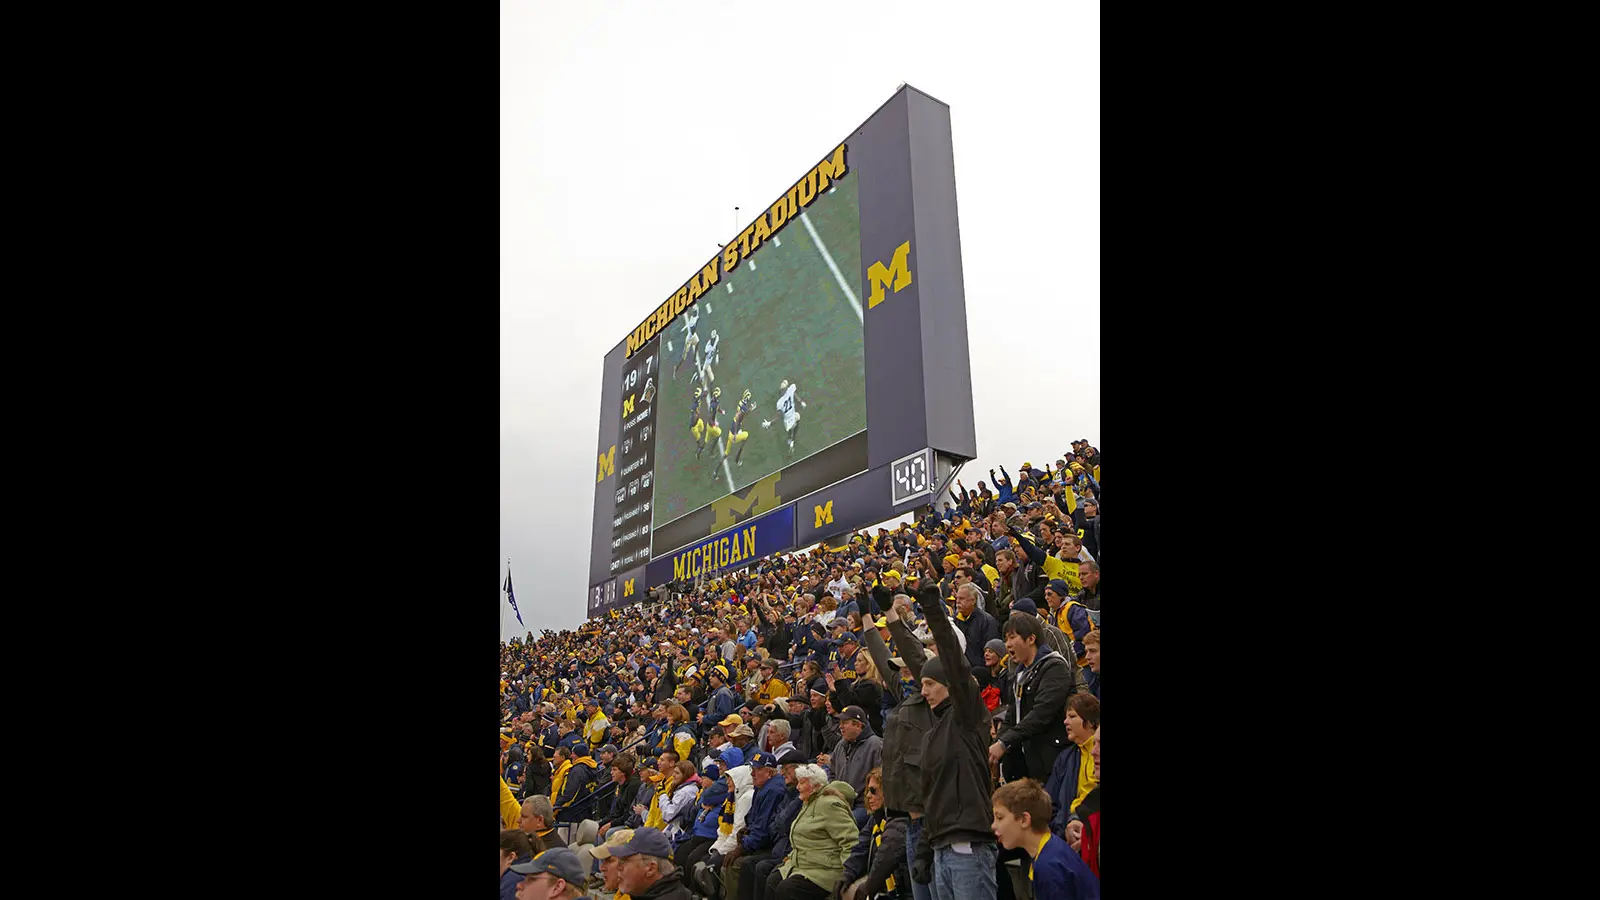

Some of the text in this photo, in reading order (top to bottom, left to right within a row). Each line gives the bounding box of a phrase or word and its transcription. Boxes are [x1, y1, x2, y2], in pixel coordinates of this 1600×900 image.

[625, 143, 849, 359] MICHIGAN STADIUM
[867, 240, 912, 310] M
[624, 369, 637, 391] 19
[645, 355, 654, 375] 7
[623, 393, 636, 419] M
[597, 444, 616, 483] M
[895, 457, 926, 493] 40
[711, 470, 782, 533] M
[814, 500, 834, 528] M
[673, 525, 757, 582] MICHIGAN
[624, 577, 635, 597] M
